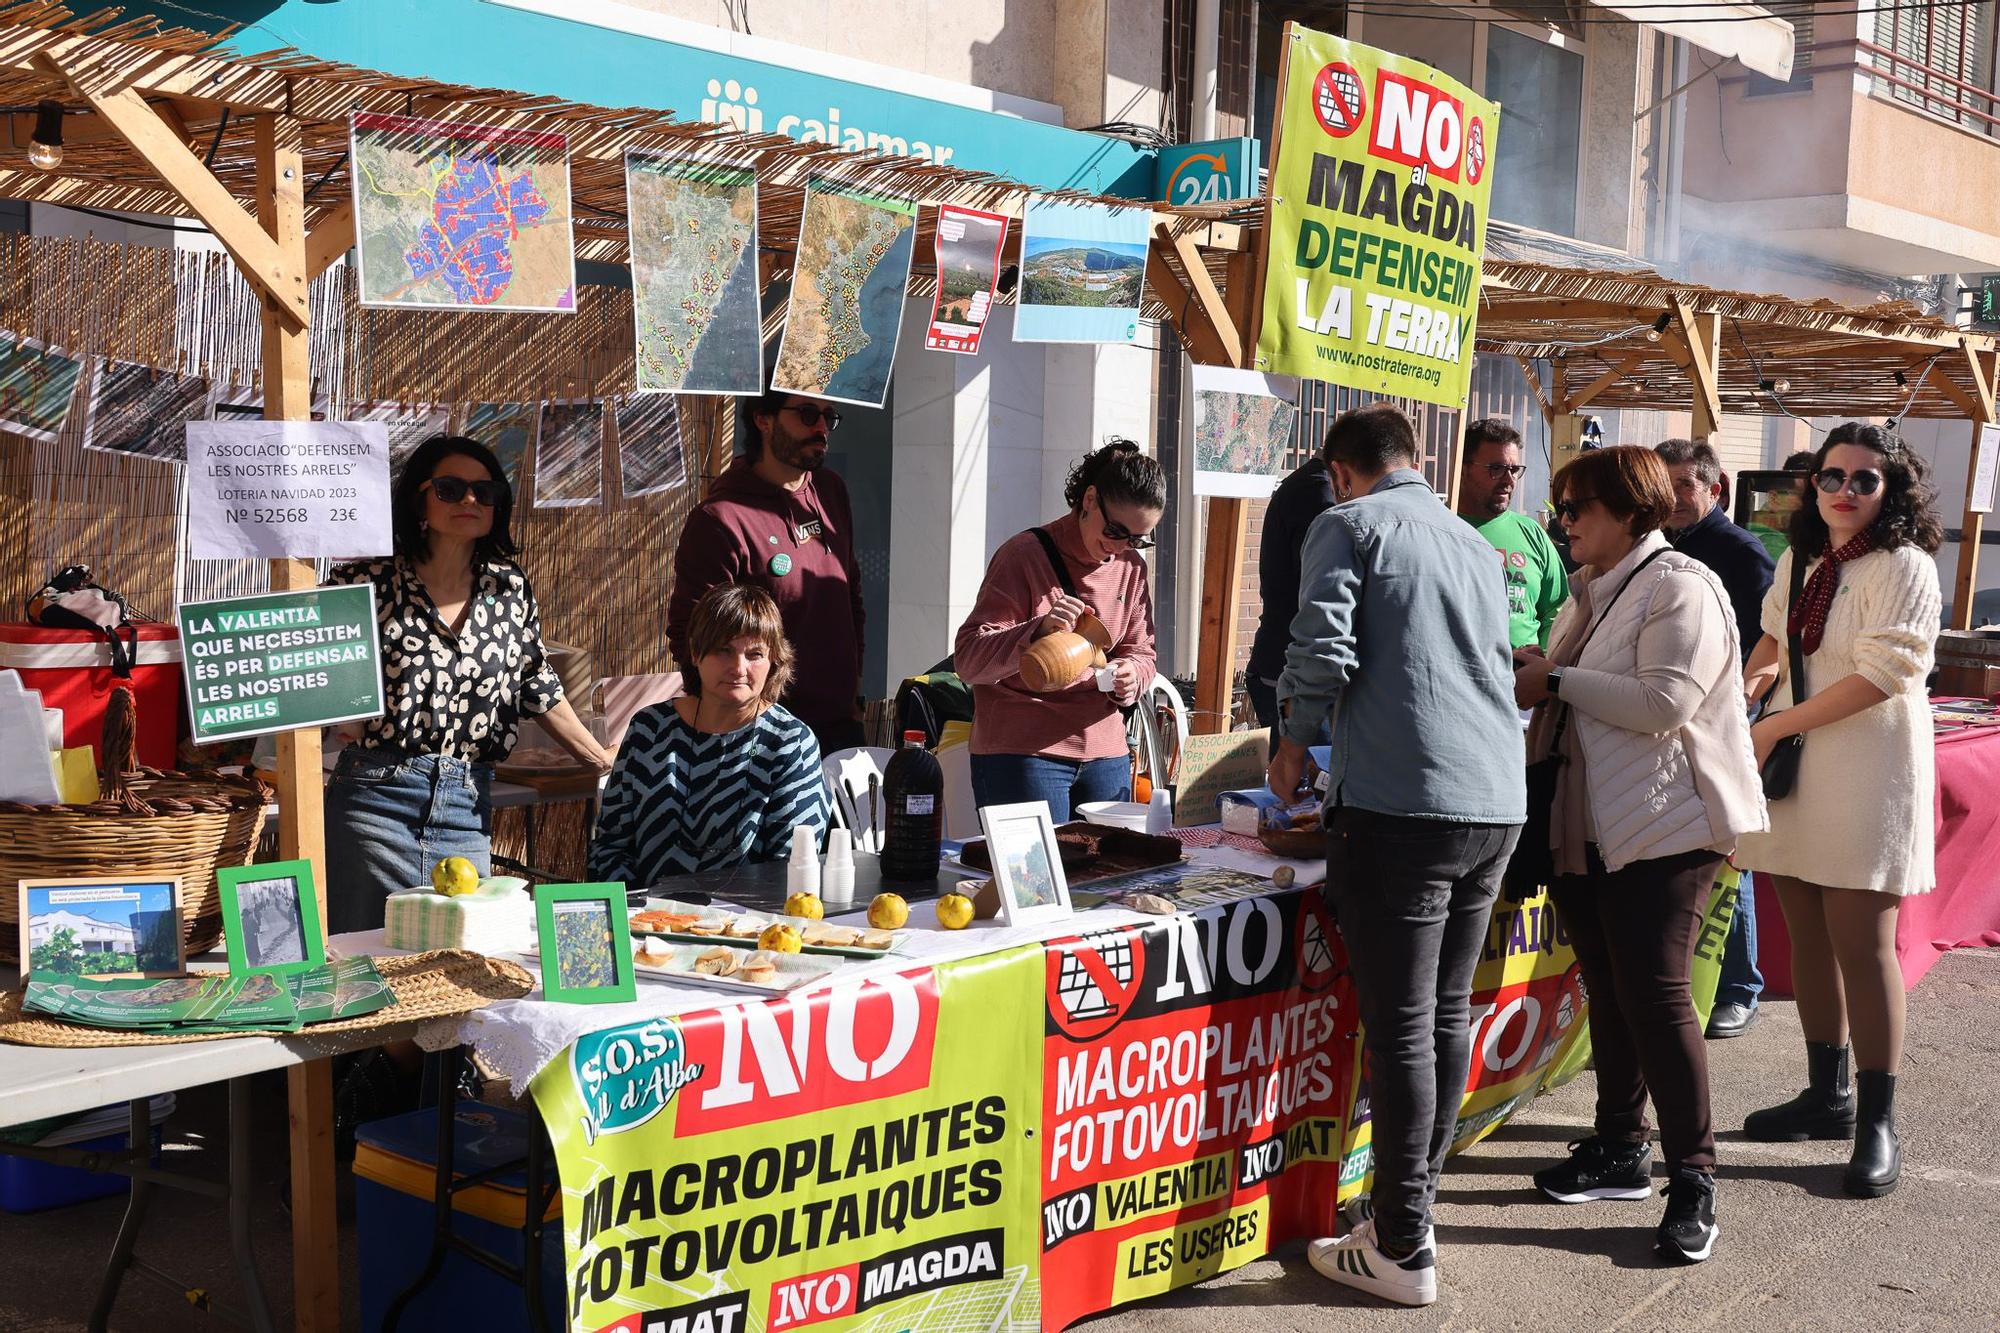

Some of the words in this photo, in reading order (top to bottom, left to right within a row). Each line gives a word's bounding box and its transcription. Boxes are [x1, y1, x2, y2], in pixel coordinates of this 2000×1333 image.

[1376, 80, 1460, 169] NO
[1306, 152, 1476, 252] MAGDA
[1411, 164, 1428, 186] al
[1296, 218, 1473, 308] DEFENSEM
[1296, 279, 1352, 340] LA
[1365, 294, 1466, 365] TERRA
[1316, 344, 1441, 387] www.nostraterra.org
[208, 464, 231, 477] LES
[235, 463, 298, 477] NOSTRES
[218, 489, 265, 500] LOTERIA
[271, 488, 325, 500] NAVIDAD
[329, 488, 357, 499] 2023
[226, 509, 248, 524] Nº
[254, 508, 308, 524] 52568
[330, 508, 358, 522] 23€
[795, 520, 821, 540] VANS
[188, 618, 216, 636] LA
[218, 606, 320, 632] VALENTIA
[191, 638, 235, 657] QUE
[239, 623, 361, 653] NECESSITEM
[194, 660, 220, 681] ÉS
[225, 657, 264, 677] PER
[268, 644, 368, 672] DEFENSAR
[197, 684, 233, 703] LES
[238, 671, 329, 698] NOSTRES
[200, 700, 278, 726] ARRELS
[1155, 897, 1283, 1004] NO
[702, 973, 920, 1110] NO
[1055, 995, 1339, 1116] MACROPLANTES
[1050, 1052, 1334, 1182] FOTOVOLTAIQUES
[580, 1095, 1007, 1251] MACROPLANTES
[1045, 1193, 1092, 1246] NO
[1105, 1157, 1228, 1222] VALENTIA
[1242, 1140, 1284, 1185] NO
[1285, 1120, 1337, 1169] MAT
[573, 1159, 1004, 1322] FOTOVOLTAIQUES
[1128, 1237, 1174, 1279] LES
[1179, 1208, 1259, 1265] USERES
[773, 1271, 851, 1324] NO
[863, 1241, 997, 1304] MAGDA
